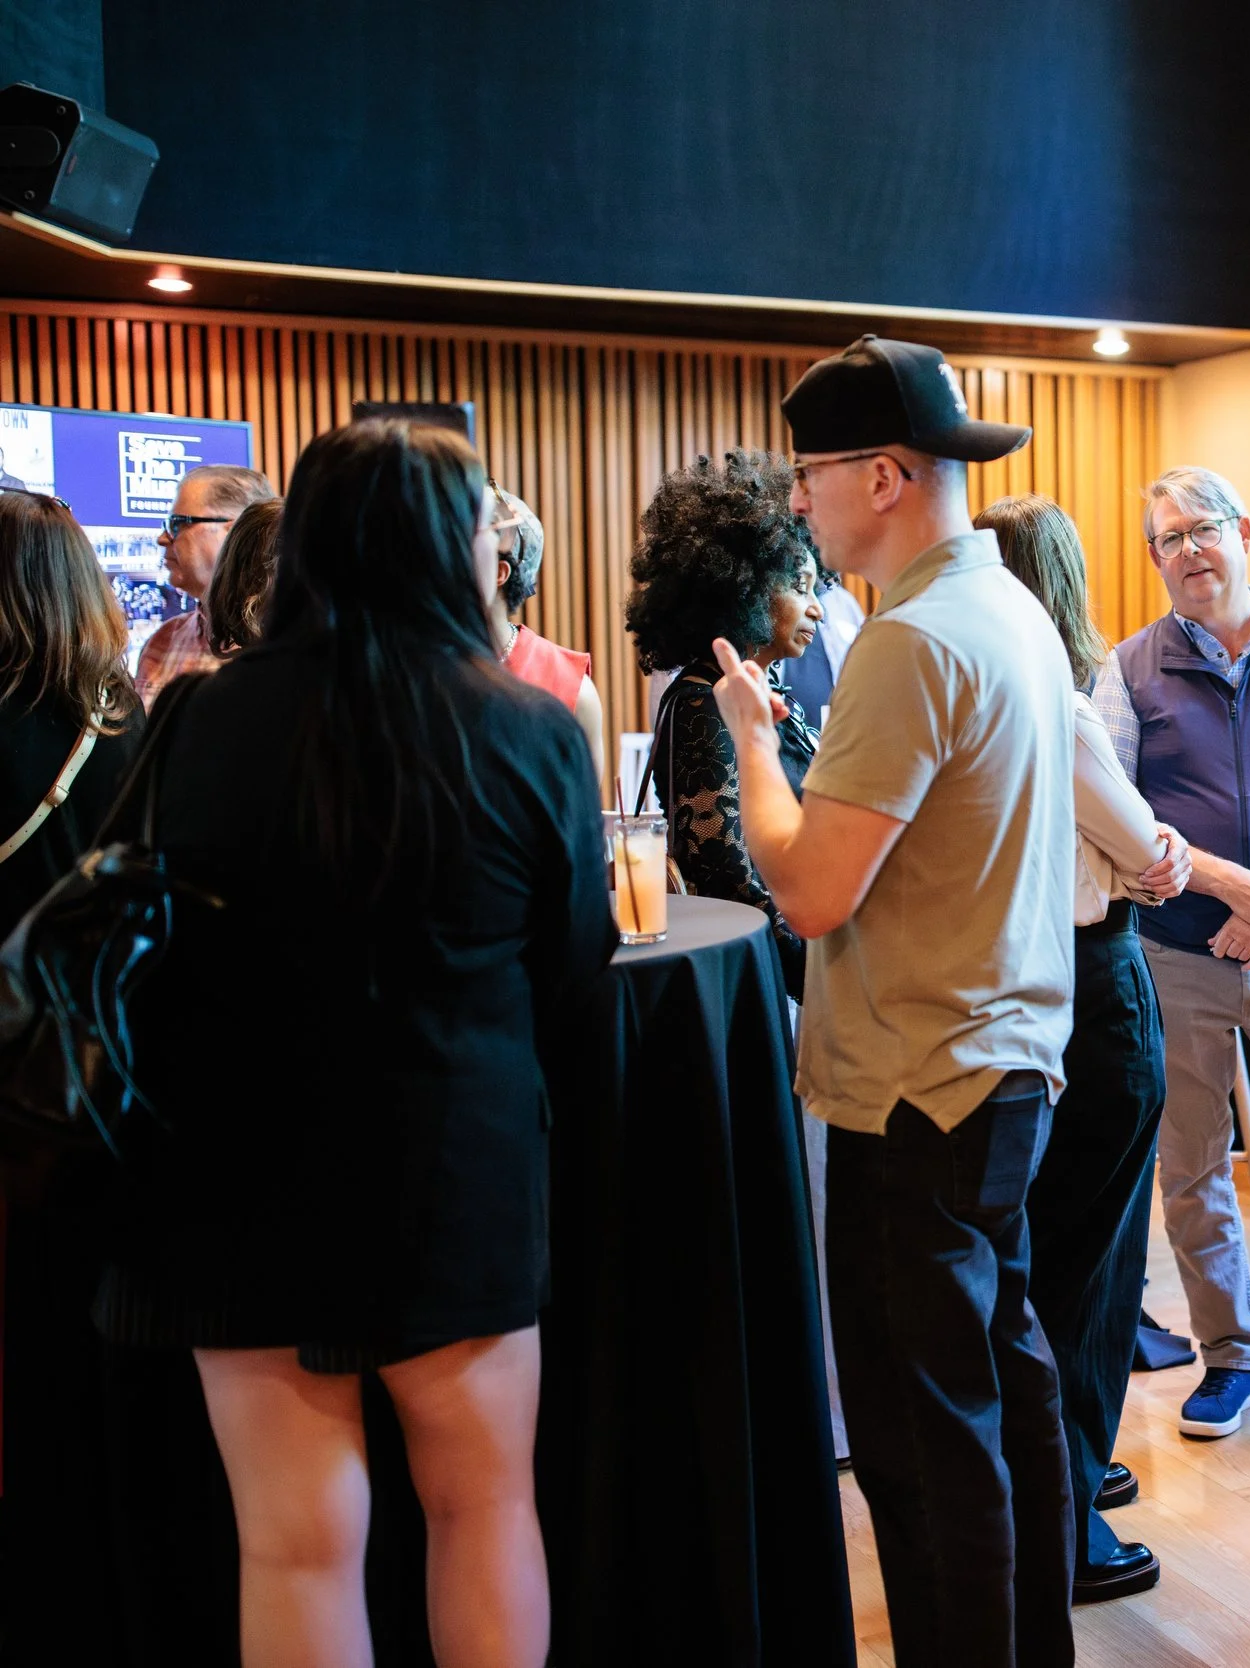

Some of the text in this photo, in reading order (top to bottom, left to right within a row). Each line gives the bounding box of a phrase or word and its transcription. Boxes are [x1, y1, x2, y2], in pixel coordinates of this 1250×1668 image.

[2, 410, 28, 429] OWN
[129, 435, 185, 459] Save
[129, 455, 176, 476] The
[130, 500, 172, 511] FOUNDA
